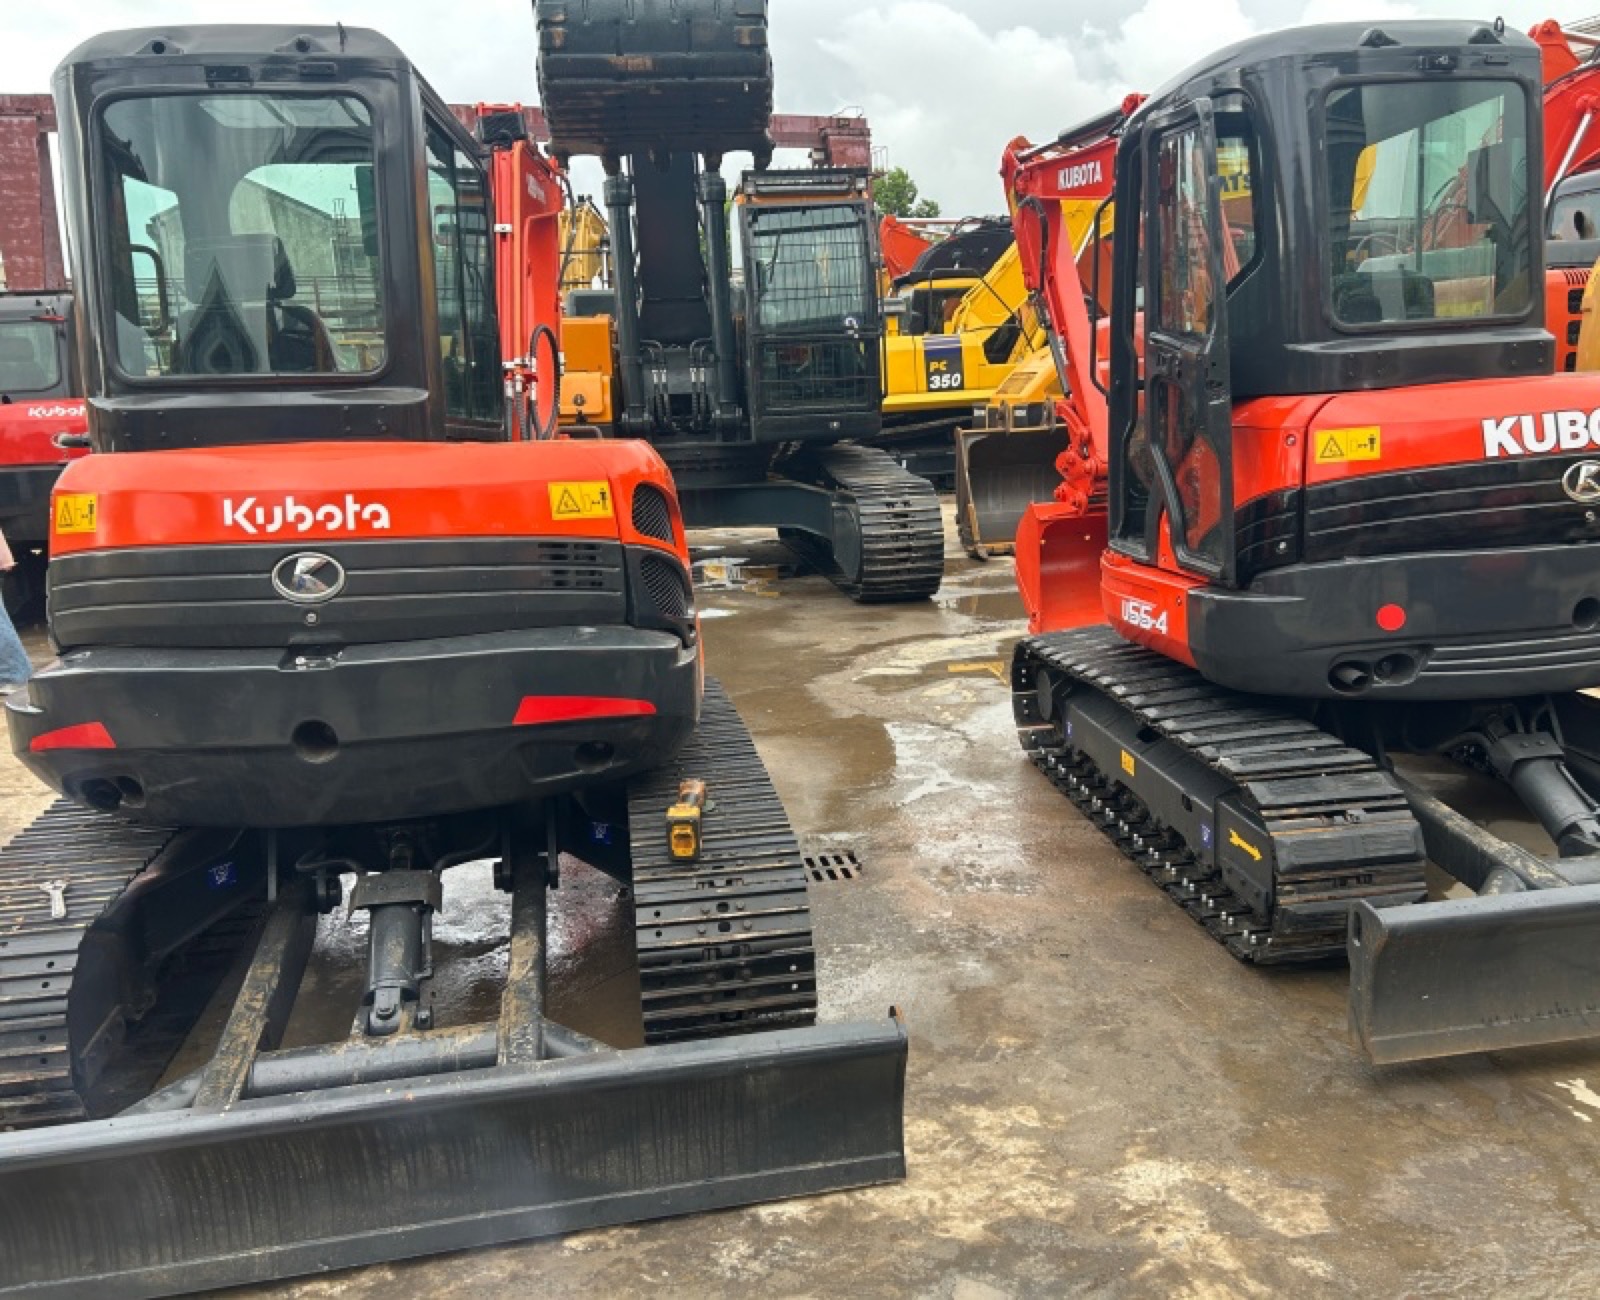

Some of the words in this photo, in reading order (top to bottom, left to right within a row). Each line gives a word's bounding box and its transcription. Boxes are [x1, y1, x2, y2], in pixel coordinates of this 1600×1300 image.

[1057, 161, 1103, 191] KUBOTA
[929, 360, 948, 372] PC
[929, 373, 962, 389] 350
[223, 494, 391, 534] Kubota
